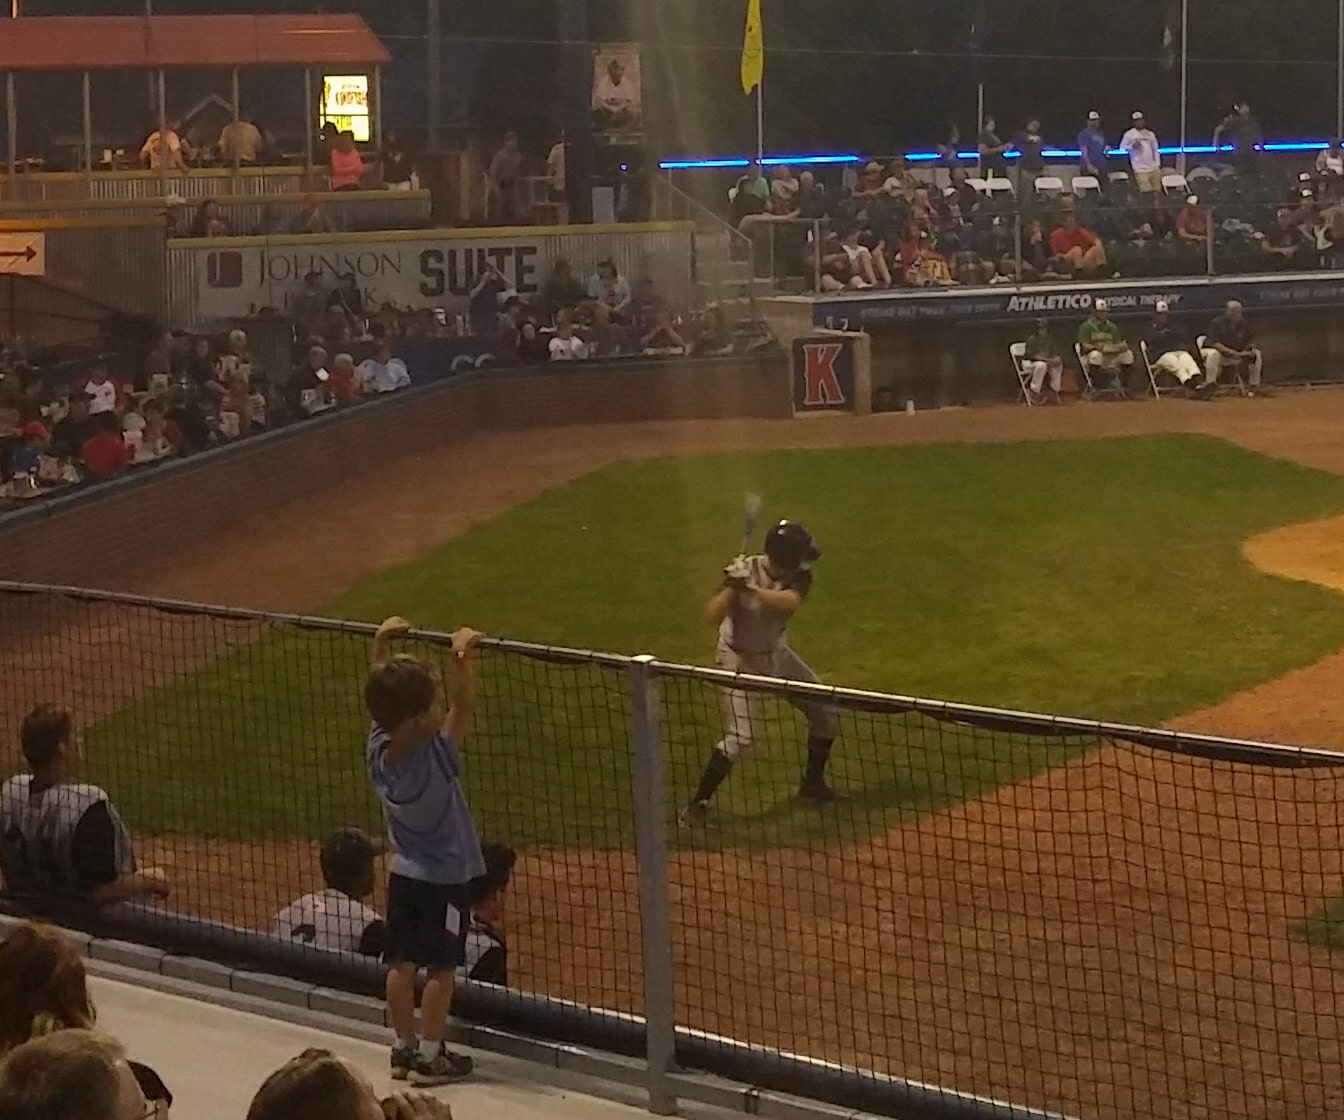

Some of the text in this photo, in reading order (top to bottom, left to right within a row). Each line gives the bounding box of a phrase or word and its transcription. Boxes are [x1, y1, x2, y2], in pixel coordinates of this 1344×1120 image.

[259, 246, 538, 297] JOHNSON SUITE
[1006, 294, 1091, 312] ATHLETICO
[1094, 295, 1136, 307] YSICAL
[802, 343, 846, 405] K
